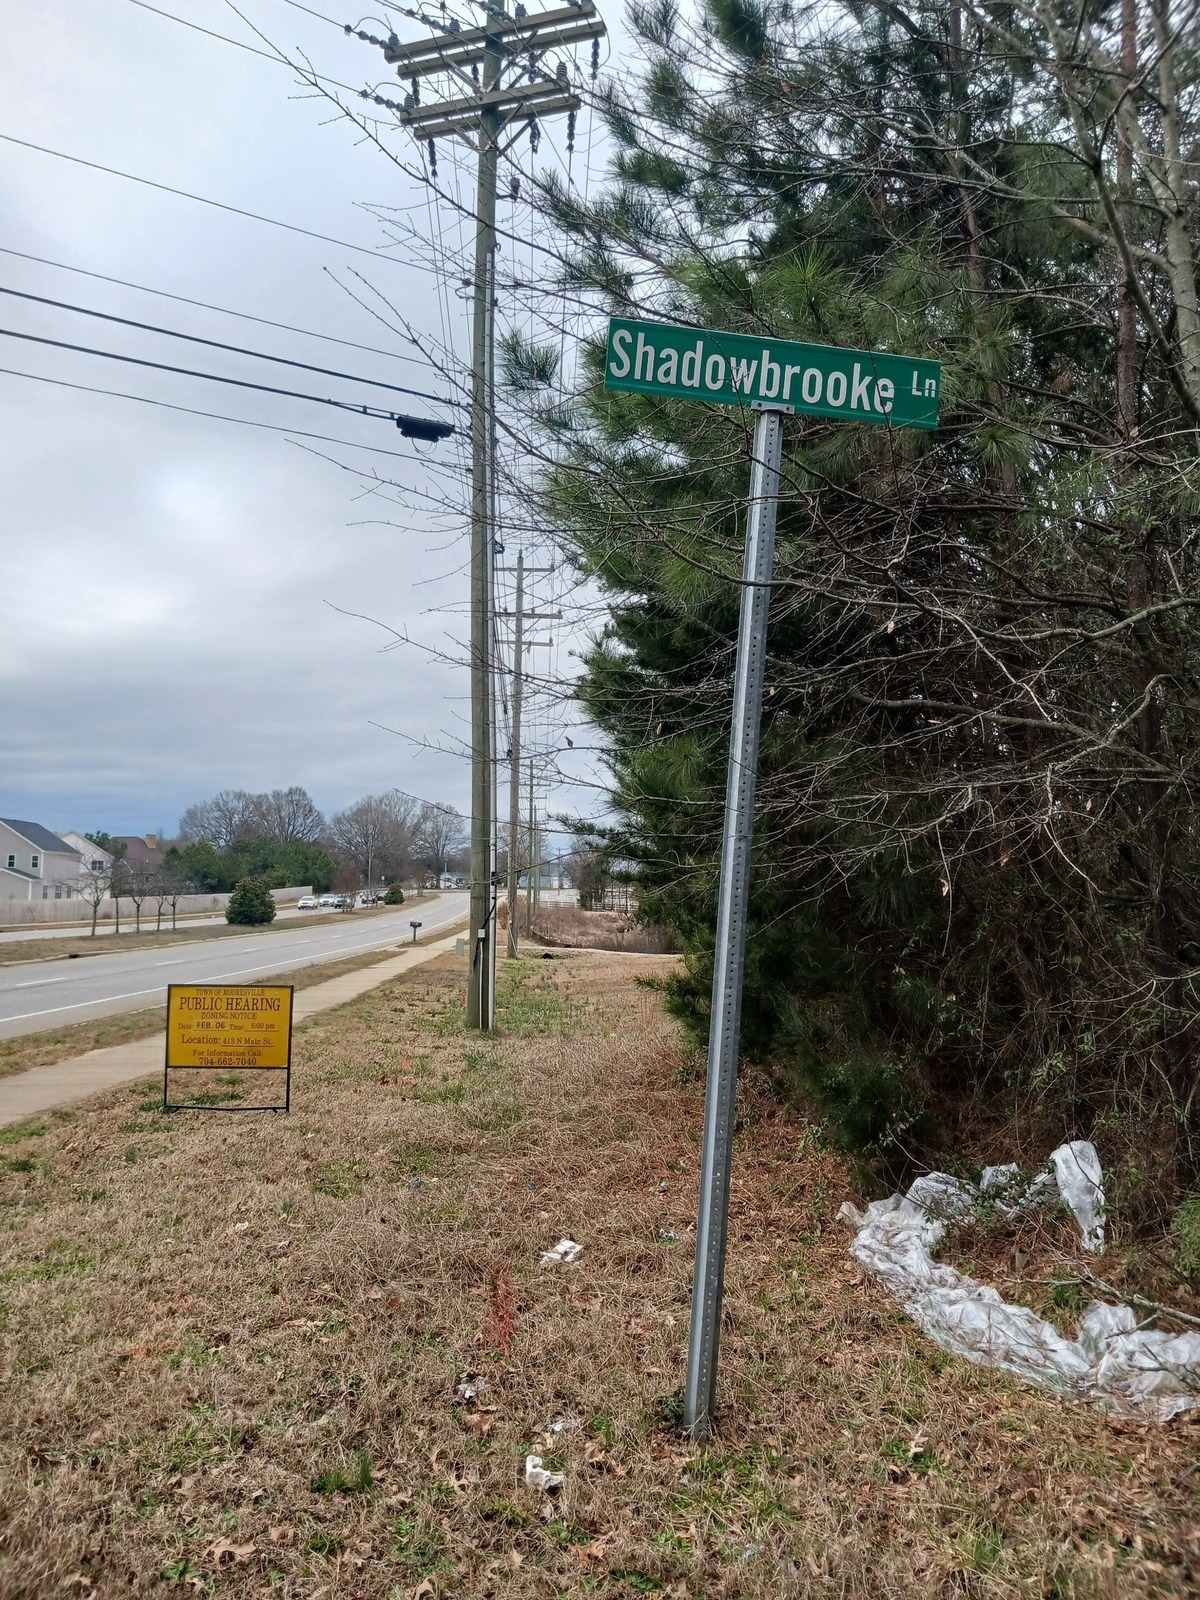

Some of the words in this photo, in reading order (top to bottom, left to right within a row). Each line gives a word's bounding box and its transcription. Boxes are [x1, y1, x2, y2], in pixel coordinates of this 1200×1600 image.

[608, 328, 895, 413] Shadowbrooke
[911, 370, 936, 397] Ln
[196, 988, 214, 996] TOWN
[179, 997, 223, 1010] PUBLIC
[225, 997, 280, 1011] HEARING
[181, 1034, 220, 1044] Location:
[206, 1049, 246, 1057] Information
[199, 1057, 257, 1066] 704-662-7040
